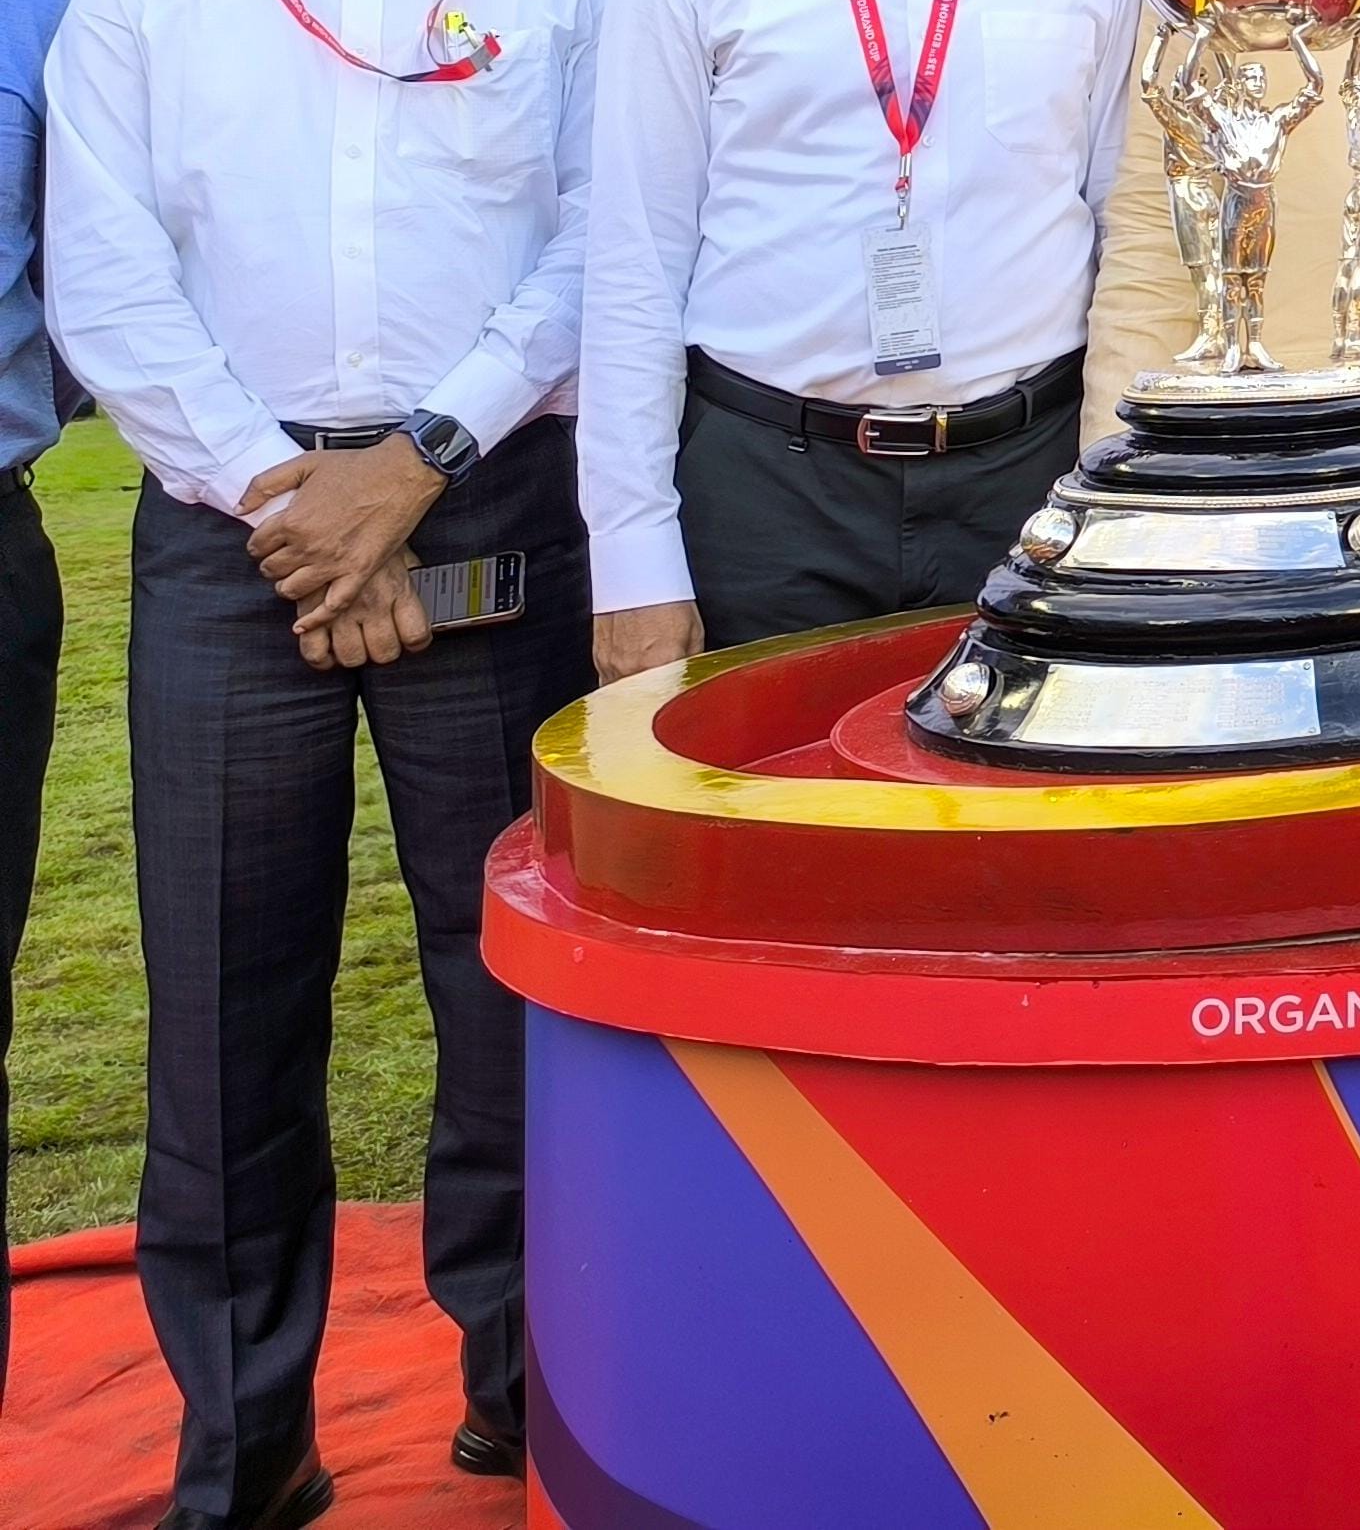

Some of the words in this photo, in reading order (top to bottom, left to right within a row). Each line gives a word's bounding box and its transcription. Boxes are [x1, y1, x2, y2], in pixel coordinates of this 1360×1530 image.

[857, 0, 875, 39] DURAND
[867, 39, 881, 62] CUP
[932, 3, 950, 48] EDITION
